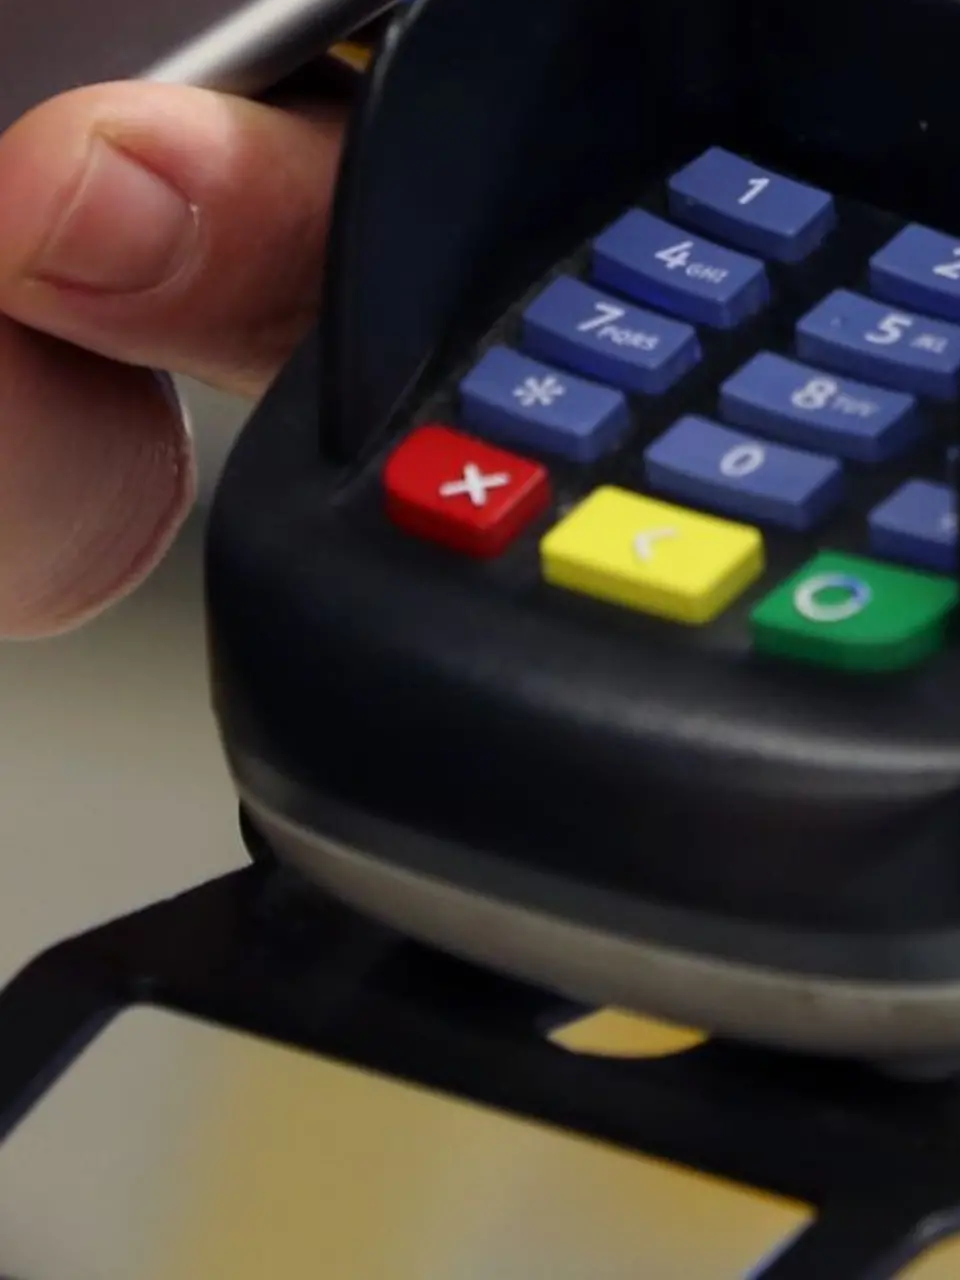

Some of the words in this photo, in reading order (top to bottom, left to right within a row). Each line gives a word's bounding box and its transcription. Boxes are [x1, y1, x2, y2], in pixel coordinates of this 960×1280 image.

[738, 177, 770, 205] 1
[654, 240, 694, 269] 4
[576, 302, 625, 331] 7
[864, 311, 913, 345] 5
[791, 378, 837, 409] 8
[720, 444, 764, 477] 0
